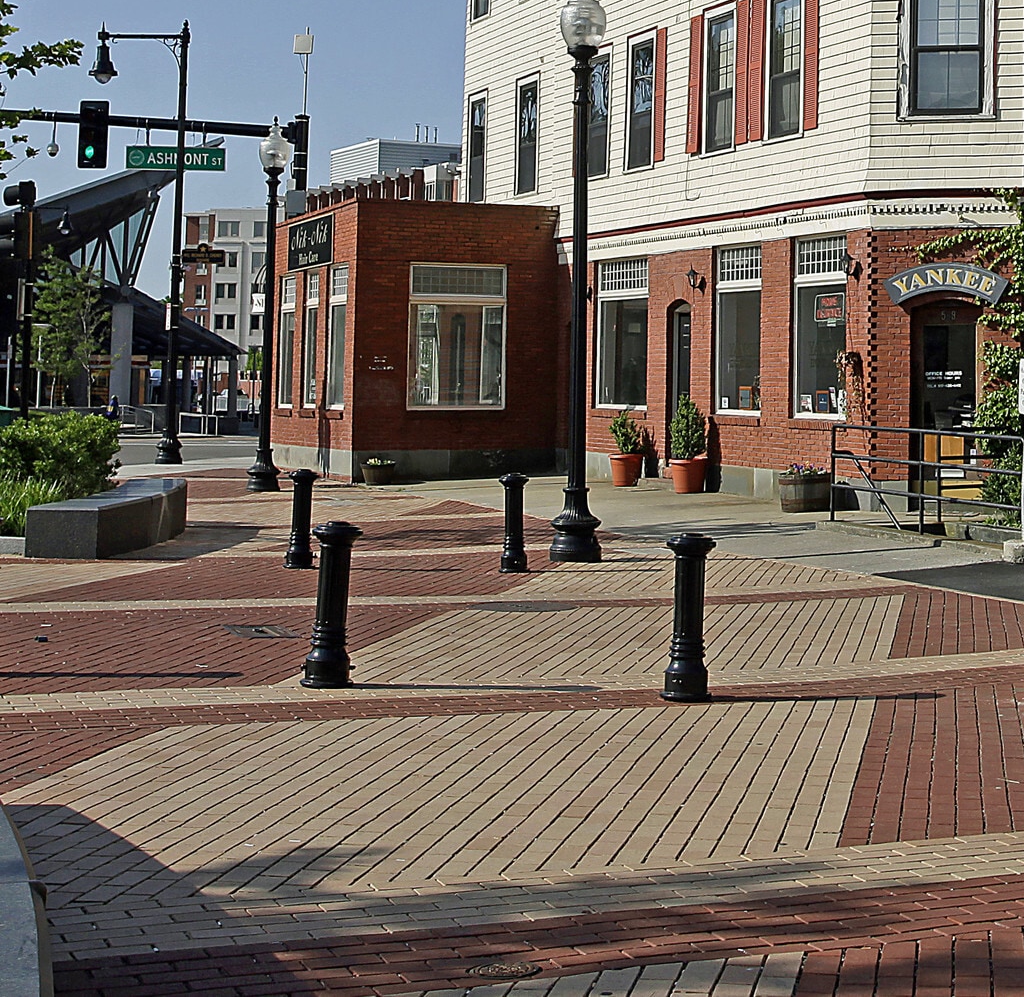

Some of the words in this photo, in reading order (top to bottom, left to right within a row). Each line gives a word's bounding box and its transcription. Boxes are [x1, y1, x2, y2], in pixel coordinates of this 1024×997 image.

[147, 152, 209, 165] ASHONT
[211, 157, 222, 166] ST
[892, 268, 997, 296] YANKEE
